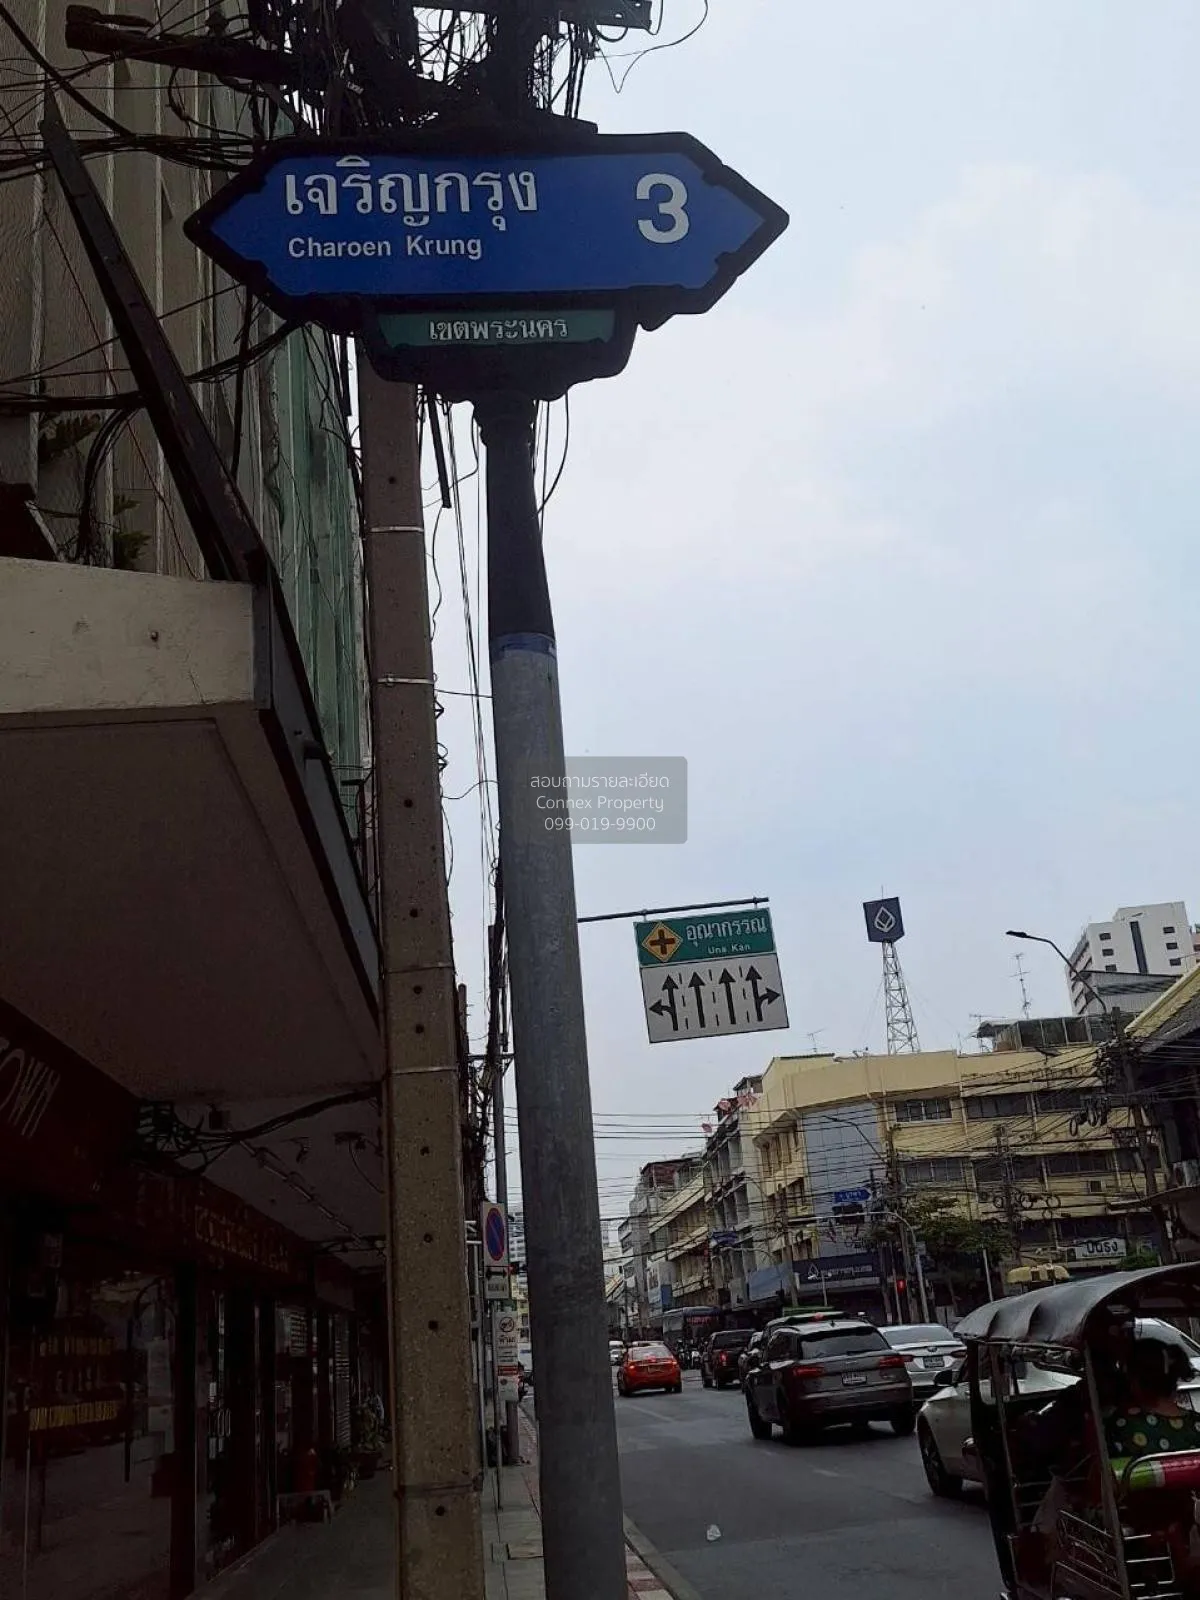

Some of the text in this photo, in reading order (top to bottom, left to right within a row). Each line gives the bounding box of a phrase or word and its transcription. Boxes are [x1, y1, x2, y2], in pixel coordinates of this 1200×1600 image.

[285, 155, 538, 231] เจริญกรุง
[636, 172, 690, 244] 3
[288, 235, 482, 260] Charoen Krung
[429, 319, 568, 340] เขตพระนคร
[686, 917, 768, 947] อุณากรรณ
[731, 943, 752, 952] Kan
